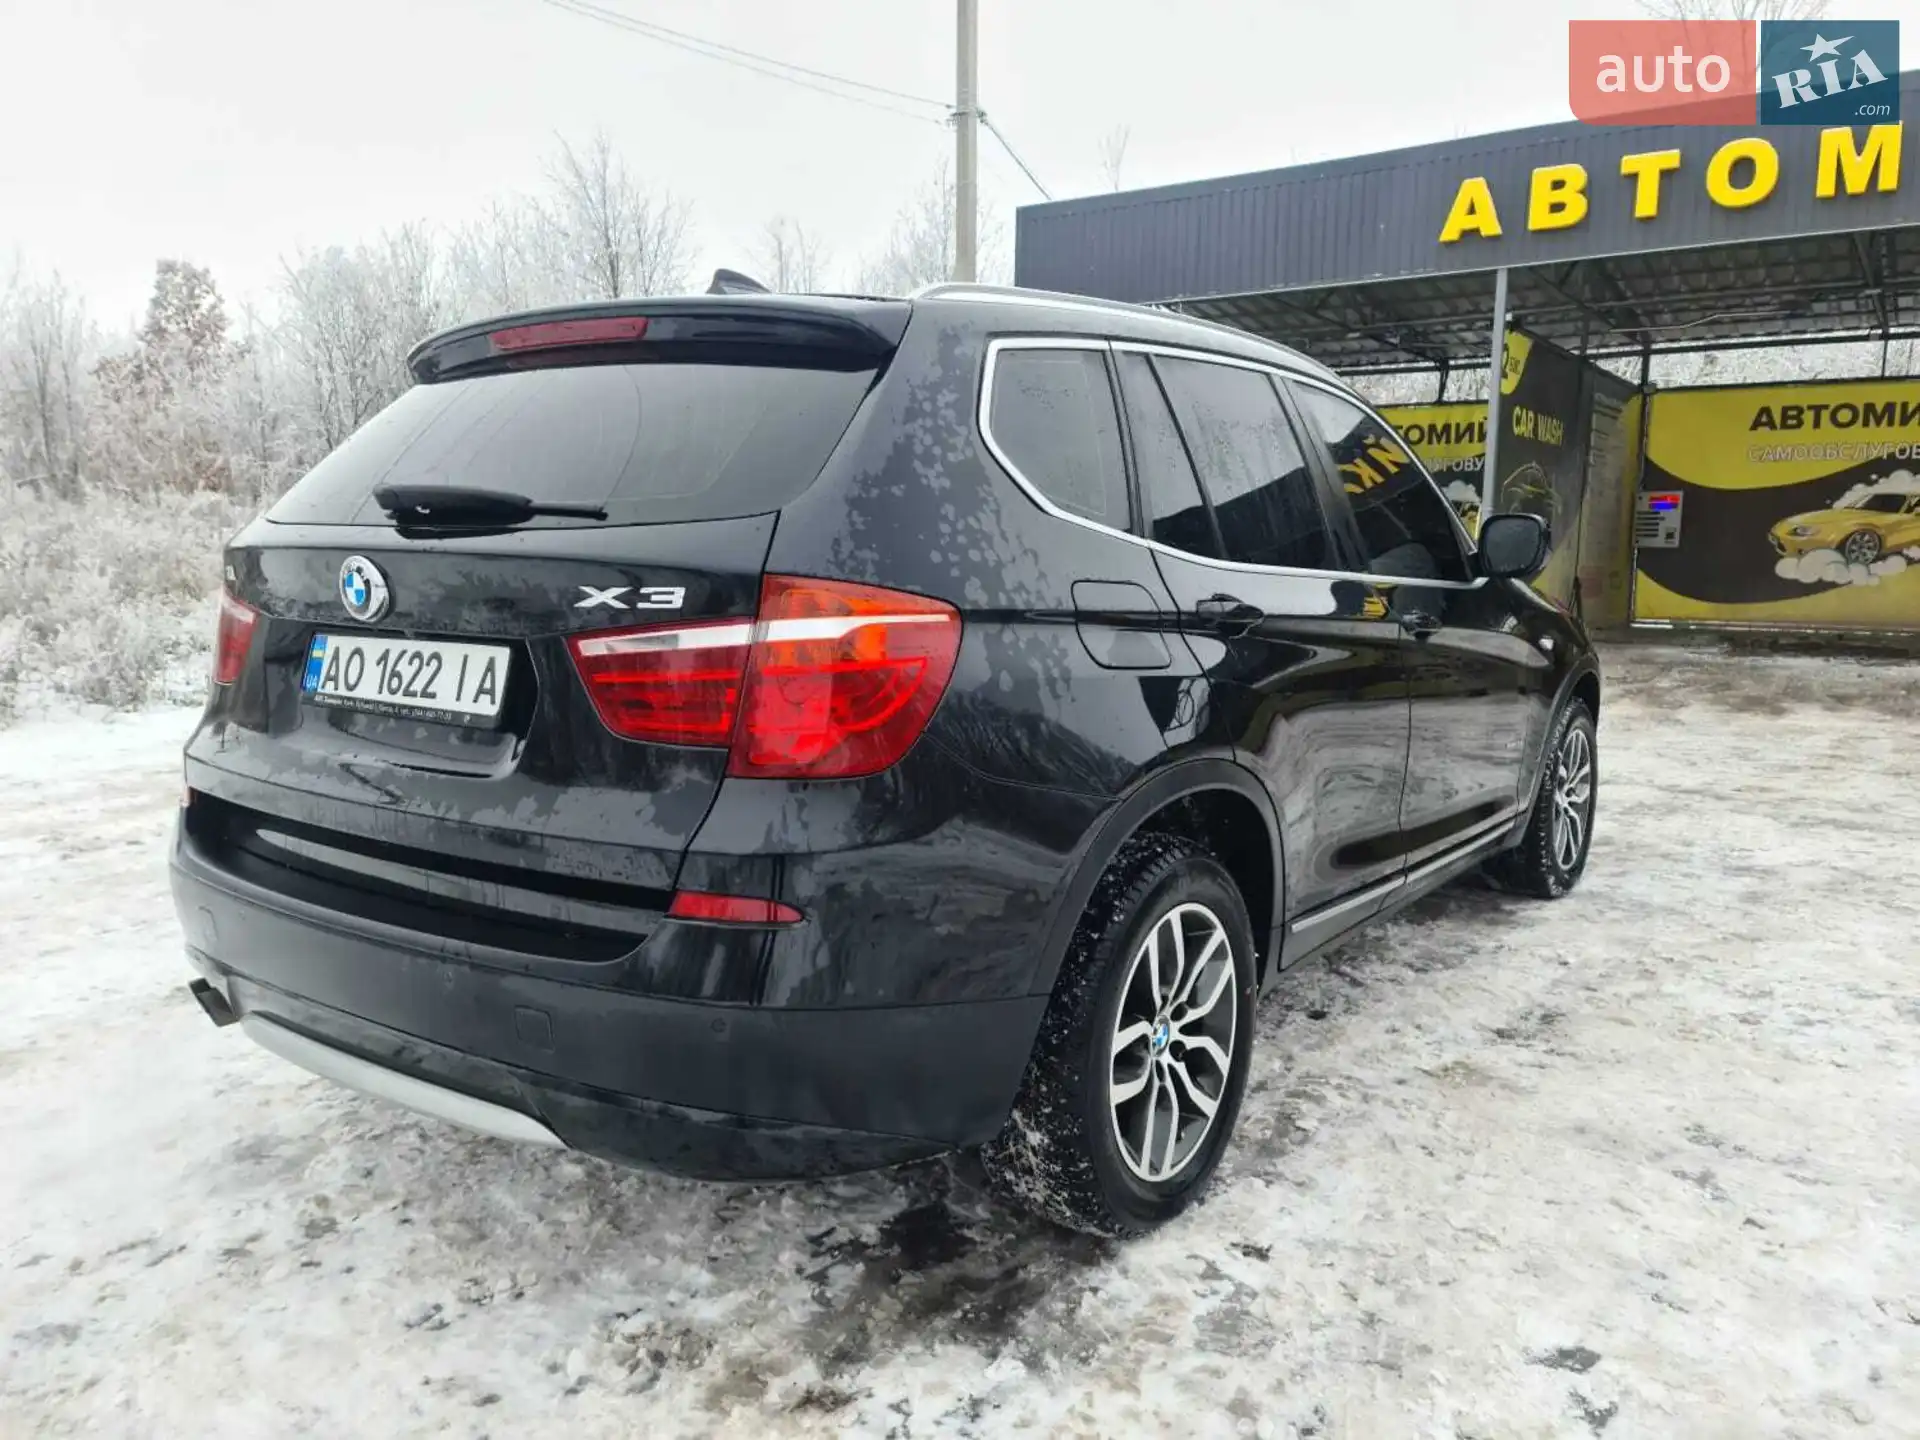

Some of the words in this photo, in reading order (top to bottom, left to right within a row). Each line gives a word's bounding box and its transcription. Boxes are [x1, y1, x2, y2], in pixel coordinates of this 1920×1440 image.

[1439, 120, 1903, 243] АВТОМ
[1513, 405, 1534, 440] CAR
[1537, 412, 1564, 446] WASH
[1749, 401, 1920, 431] АВТОМИ
[573, 586, 686, 609] X3
[321, 646, 365, 692] AO
[375, 648, 443, 699] 1622
